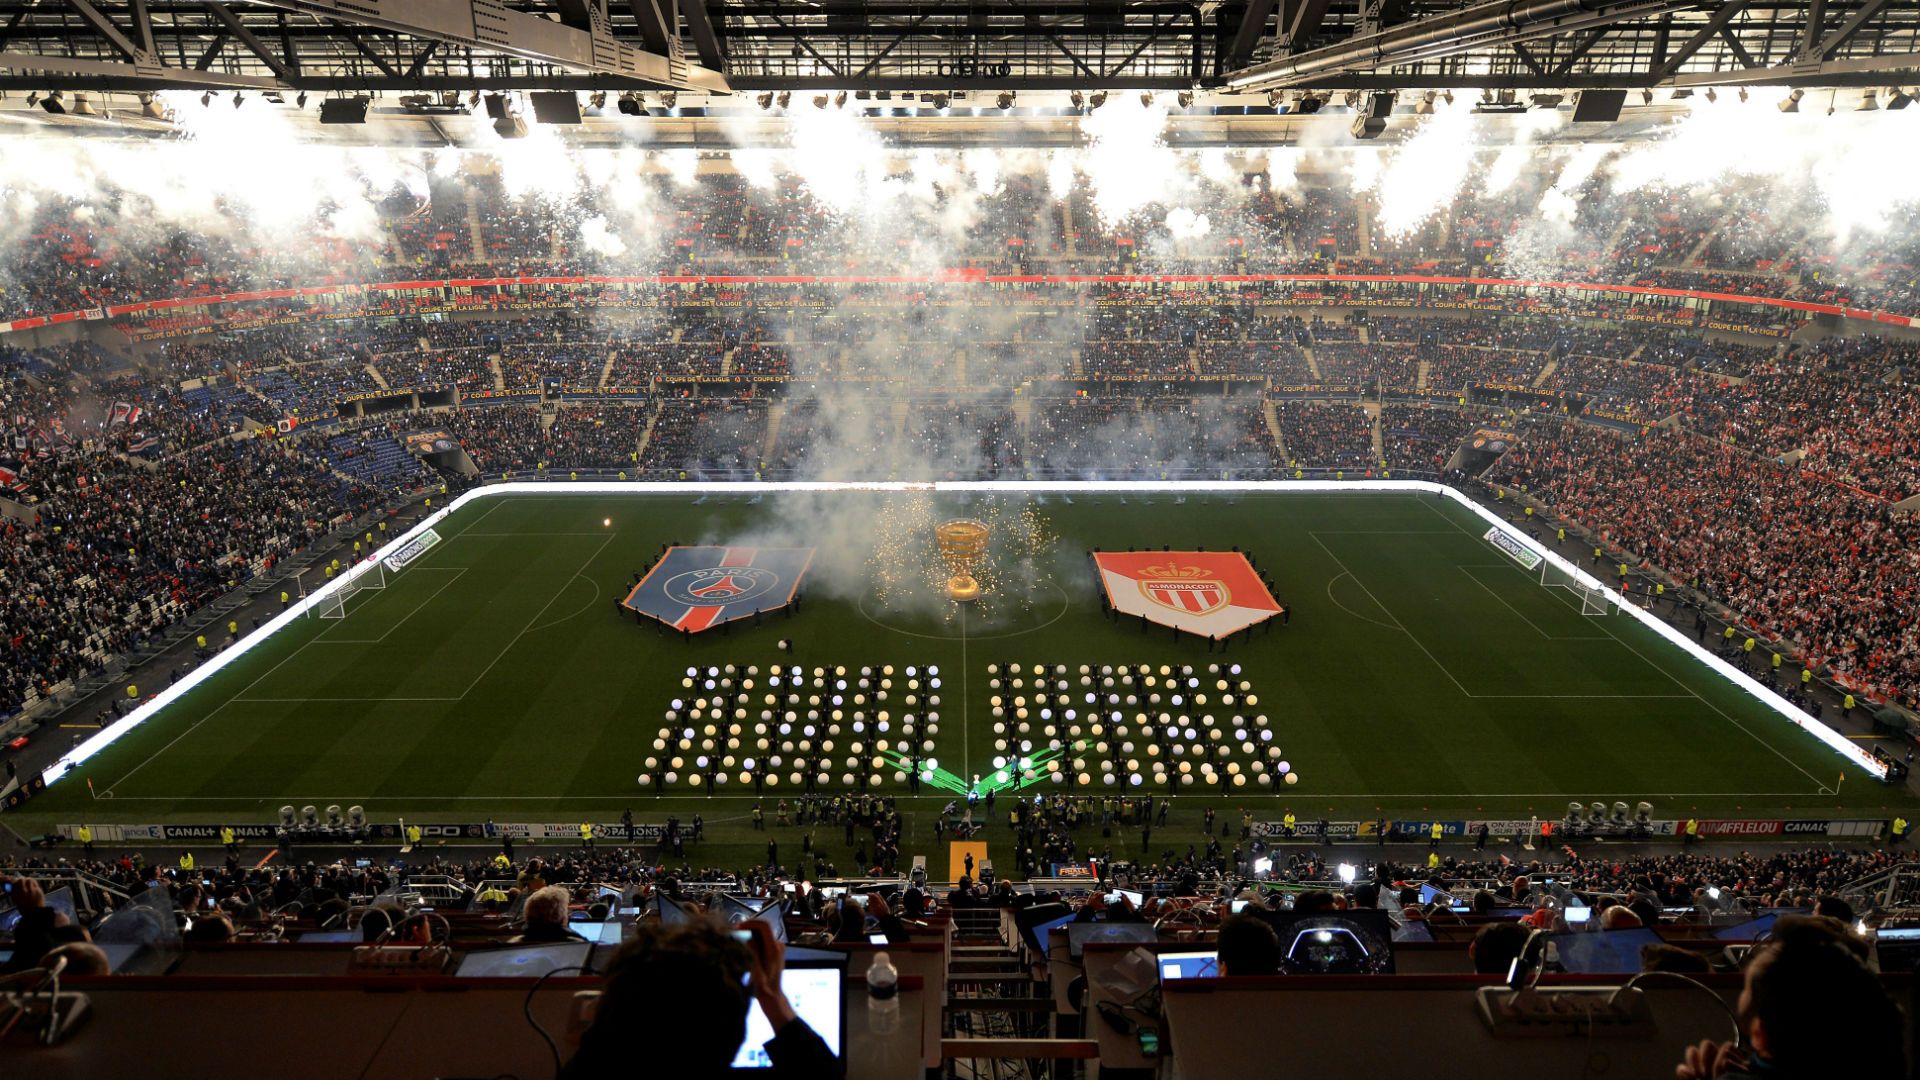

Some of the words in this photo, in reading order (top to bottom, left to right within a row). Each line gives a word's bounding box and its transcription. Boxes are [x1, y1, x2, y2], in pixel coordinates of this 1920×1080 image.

[1708, 322, 1730, 330] COUPE
[1759, 328, 1778, 336] LIGUE
[693, 569, 763, 578] PARIS
[167, 827, 216, 837] CANAL+
[225, 827, 269, 836] ANAL+
[406, 826, 460, 836] IPO
[611, 827, 660, 836] PAIONS
[1327, 825, 1357, 833] sport
[1401, 824, 1416, 833] La
[1420, 823, 1456, 833] Pte
[1717, 822, 1779, 834] AFFLELOU
